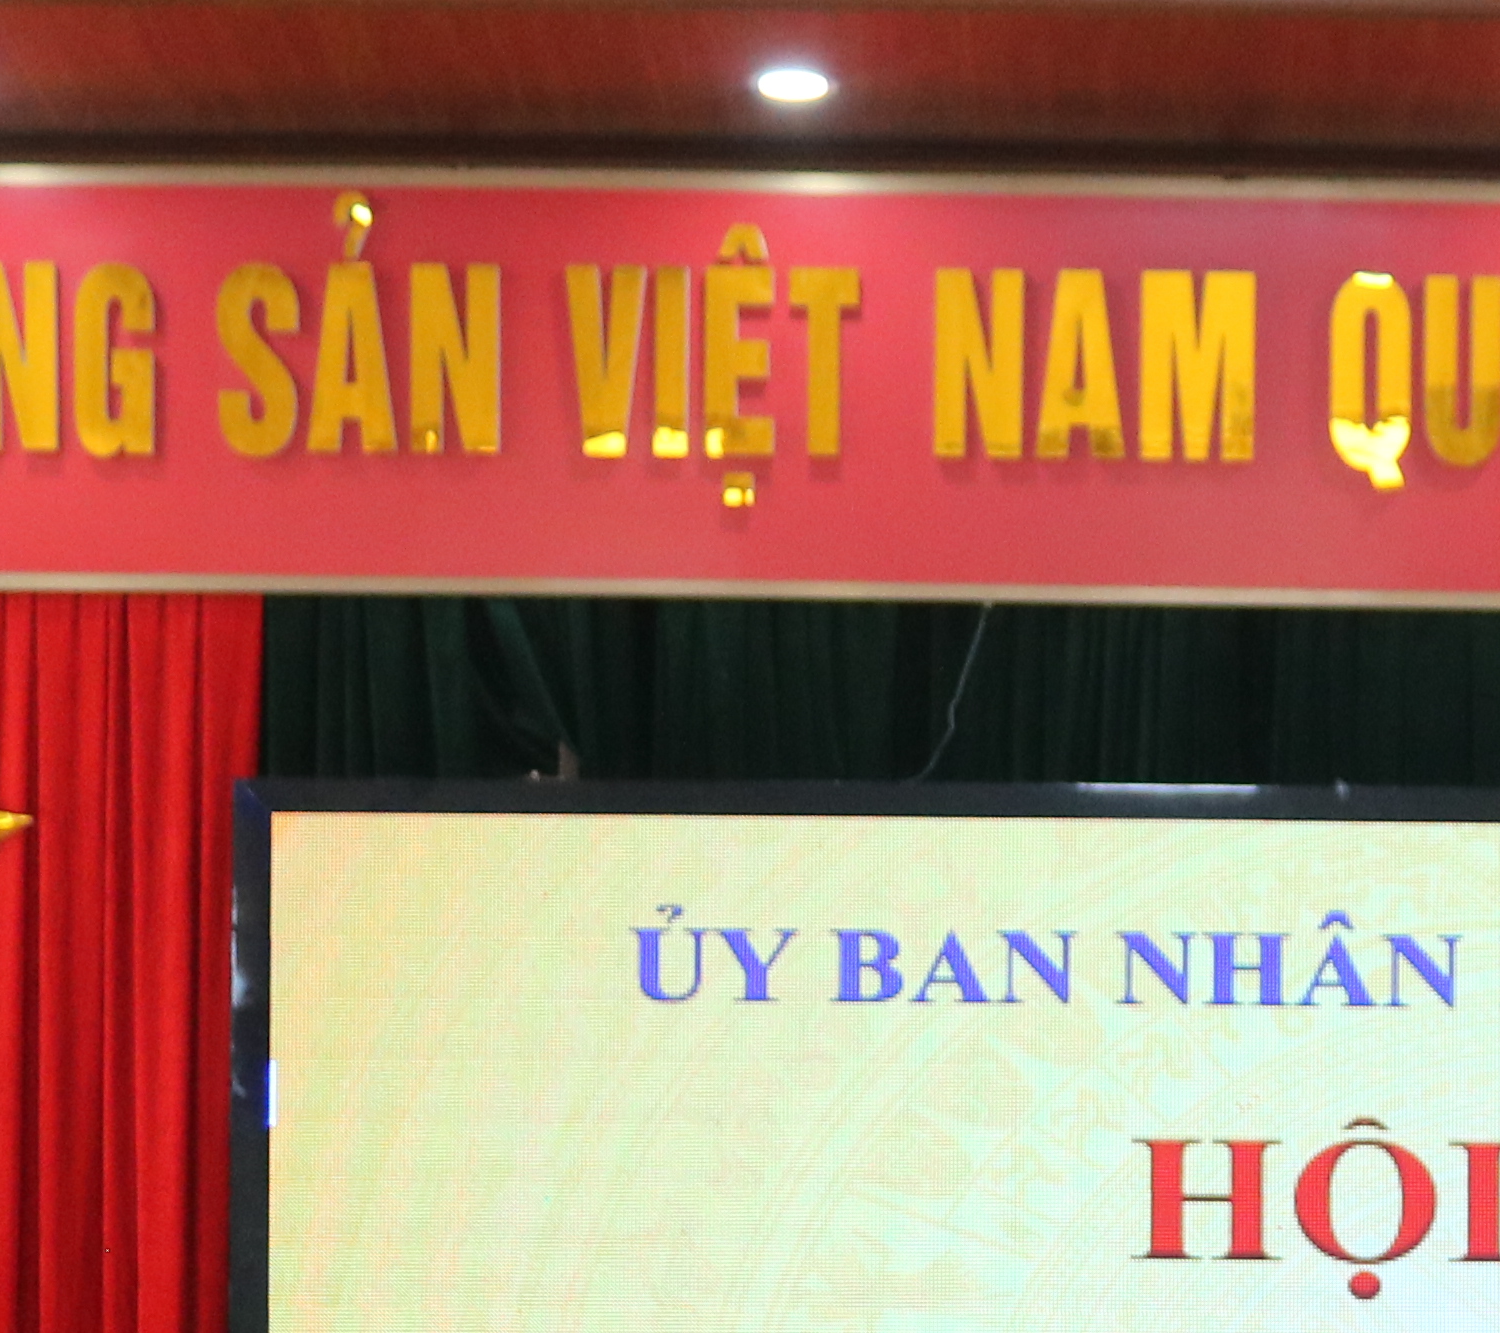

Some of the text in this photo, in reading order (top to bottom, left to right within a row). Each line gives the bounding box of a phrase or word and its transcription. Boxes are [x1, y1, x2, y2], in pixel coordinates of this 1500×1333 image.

[216, 191, 500, 457] SẢN
[565, 223, 861, 507] VIỆT
[934, 268, 1258, 463] NAM
[632, 903, 796, 1003] ỦY
[832, 928, 1075, 1004] BAN
[1117, 909, 1461, 1008] NHÂN
